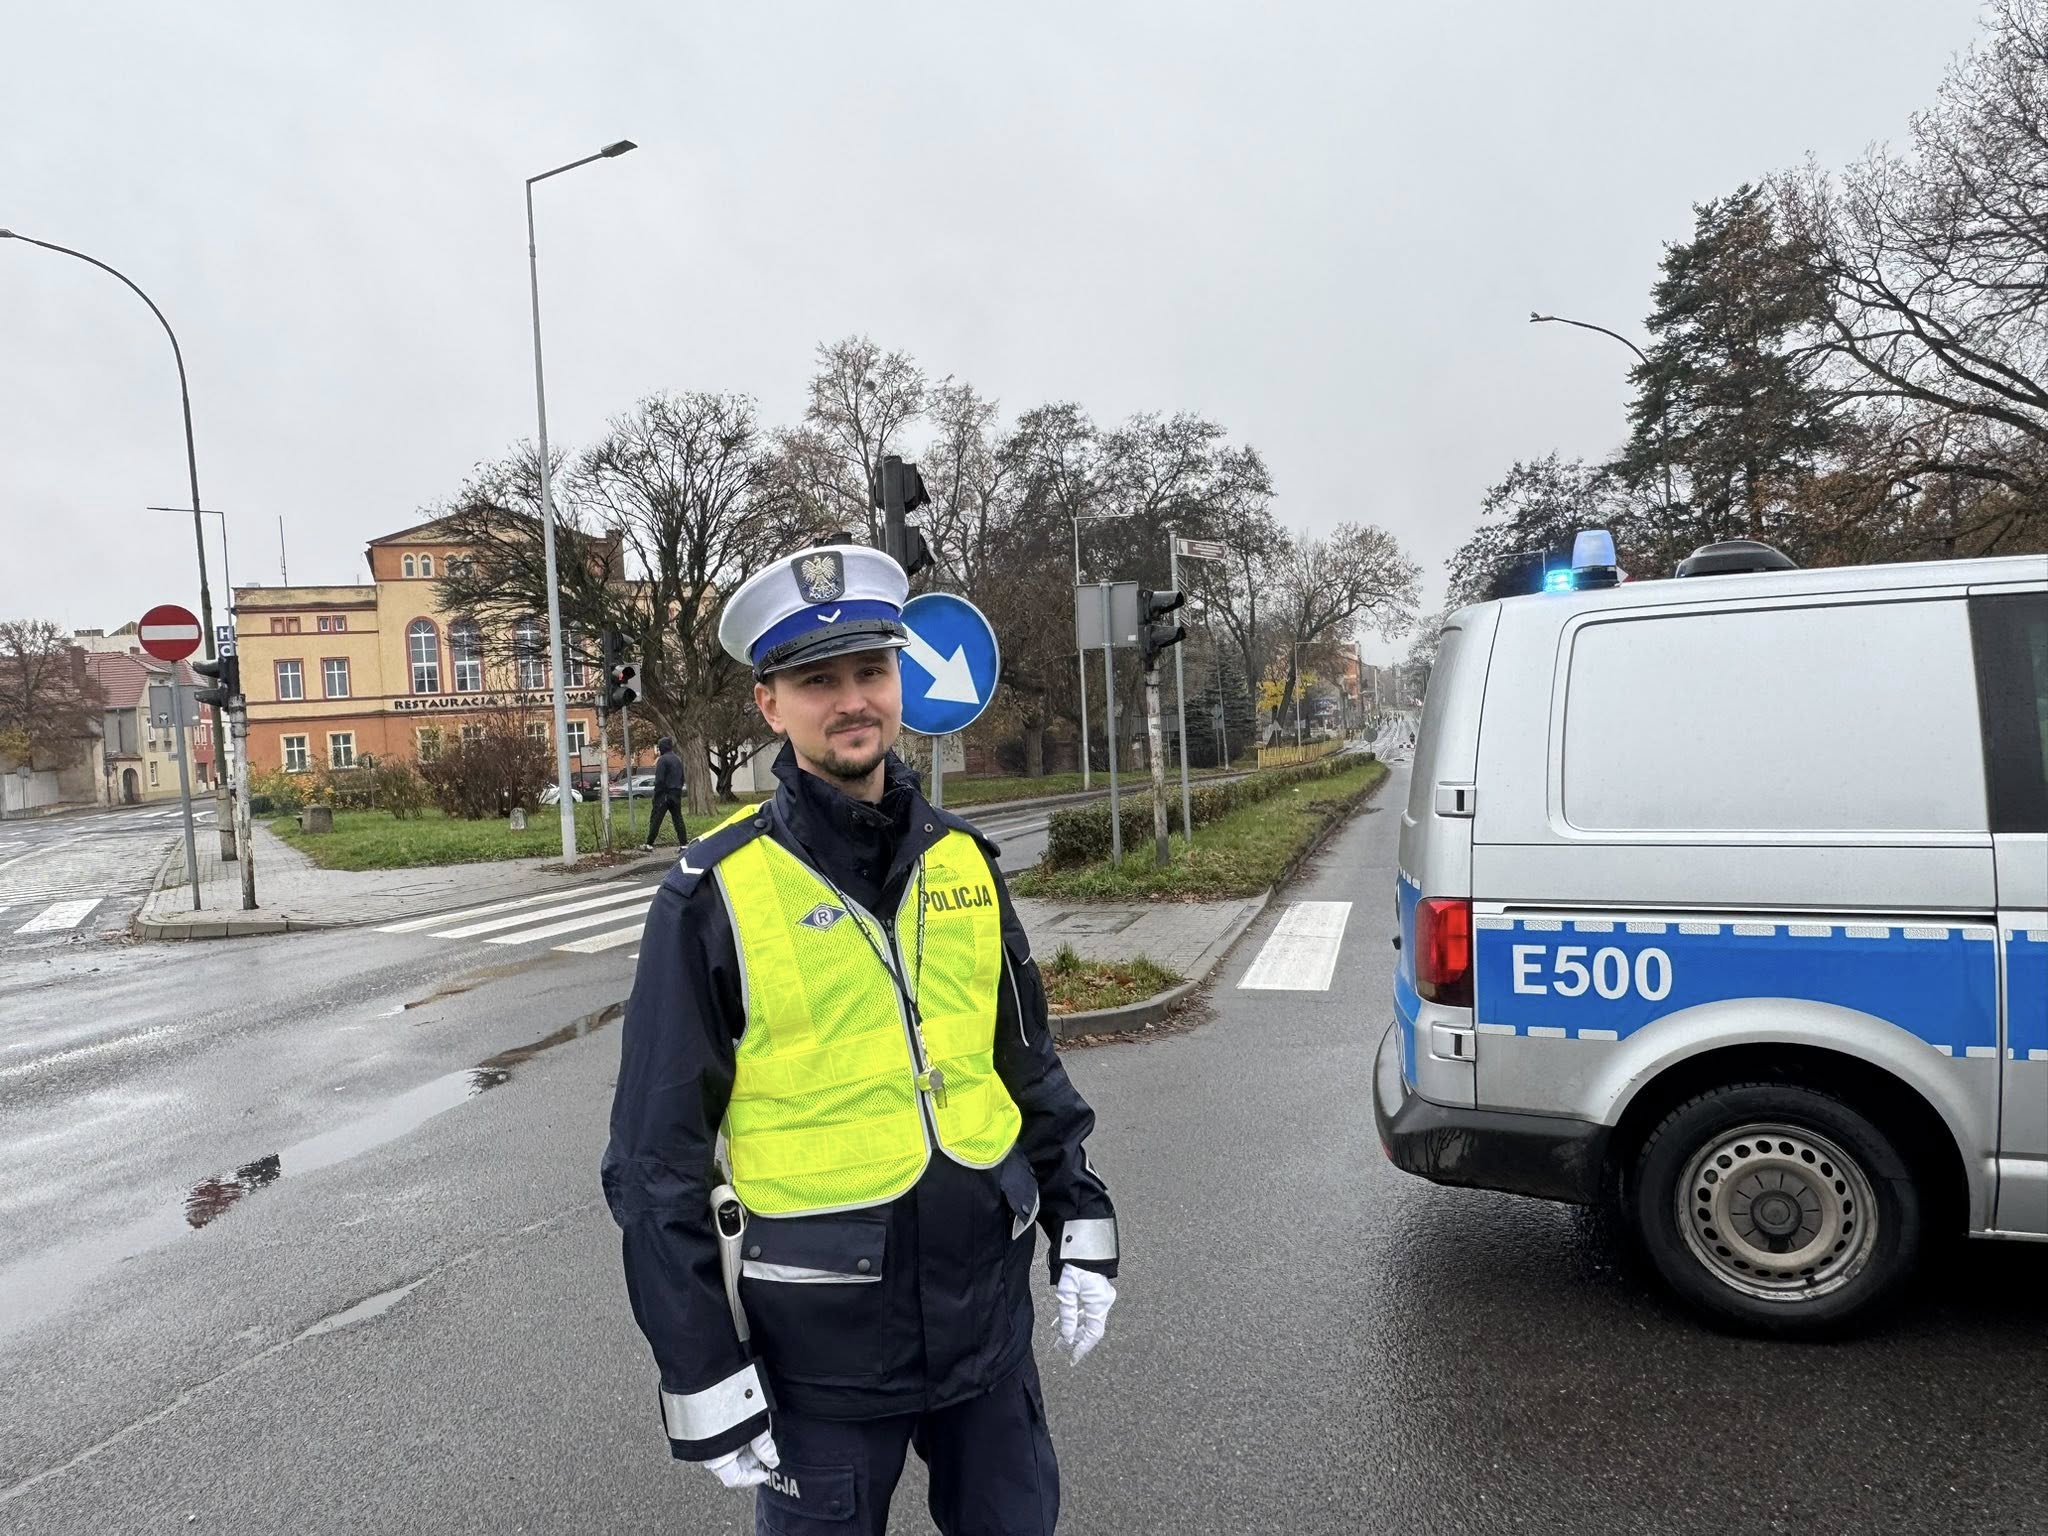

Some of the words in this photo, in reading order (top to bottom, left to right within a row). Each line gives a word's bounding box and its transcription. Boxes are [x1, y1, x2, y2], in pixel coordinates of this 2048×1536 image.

[394, 695, 498, 710] RESTAURACJA
[920, 884, 993, 913] POLICJA
[818, 911, 829, 924] R
[1512, 944, 1673, 1001] E500
[762, 1466, 801, 1499] ICJA
